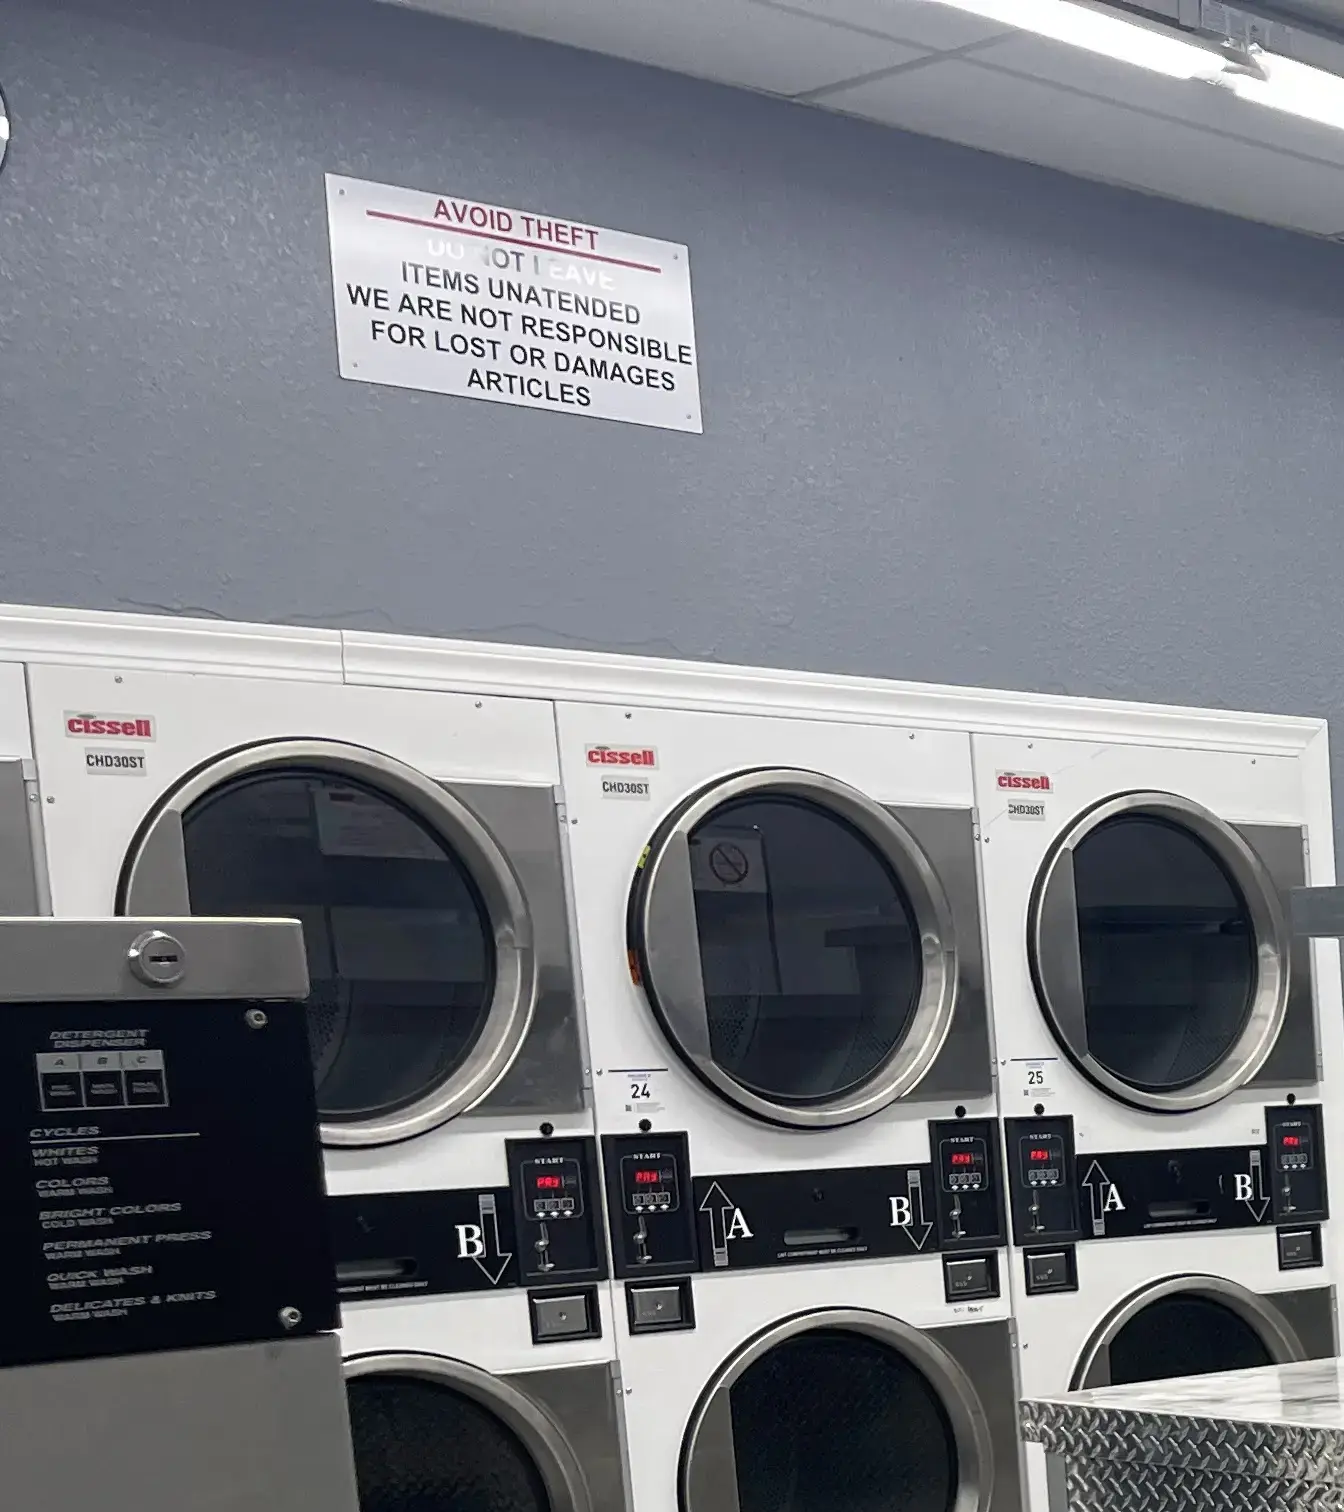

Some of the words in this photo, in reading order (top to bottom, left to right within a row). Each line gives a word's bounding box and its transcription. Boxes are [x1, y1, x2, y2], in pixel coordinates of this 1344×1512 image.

[434, 200, 513, 232] AVOID
[520, 216, 599, 250] THEFT
[401, 260, 479, 295] ITEMS
[487, 277, 641, 325] UNATENDED
[346, 284, 390, 310] WE
[398, 294, 453, 322] ARE
[461, 304, 514, 332] NOT
[521, 315, 693, 365] RESPONSIBLE
[371, 319, 427, 349] FOR
[434, 332, 501, 360] LOST
[509, 344, 547, 370] OR
[554, 352, 675, 392] DAMAGES
[466, 368, 592, 406] ARTICLES
[67, 718, 152, 737] cissell
[86, 754, 145, 769] CHD30ST
[588, 750, 654, 766] cissell
[602, 781, 649, 794] CHD30ST
[998, 775, 1050, 790] cissell
[50, 1029, 149, 1039] DETERGENT
[54, 1038, 146, 1048] DISPENSER
[1027, 1071, 1043, 1085] 25
[631, 1083, 650, 1099] 24
[30, 1126, 100, 1137] CYCLES
[32, 1146, 99, 1157] WHITES
[35, 1177, 109, 1188] COLORS
[1234, 1174, 1252, 1201] B
[1103, 1184, 1126, 1212] A
[39, 1207, 106, 1220] BRIGHT
[109, 1203, 181, 1215] COLORS
[889, 1196, 911, 1227] B
[726, 1208, 754, 1240] A
[43, 1235, 151, 1250] PERMANENT
[155, 1231, 212, 1242] PRESS
[455, 1224, 484, 1259] B
[47, 1270, 98, 1282] QUICK
[50, 1297, 146, 1313] DELICATES
[166, 1290, 216, 1302] KNITS
